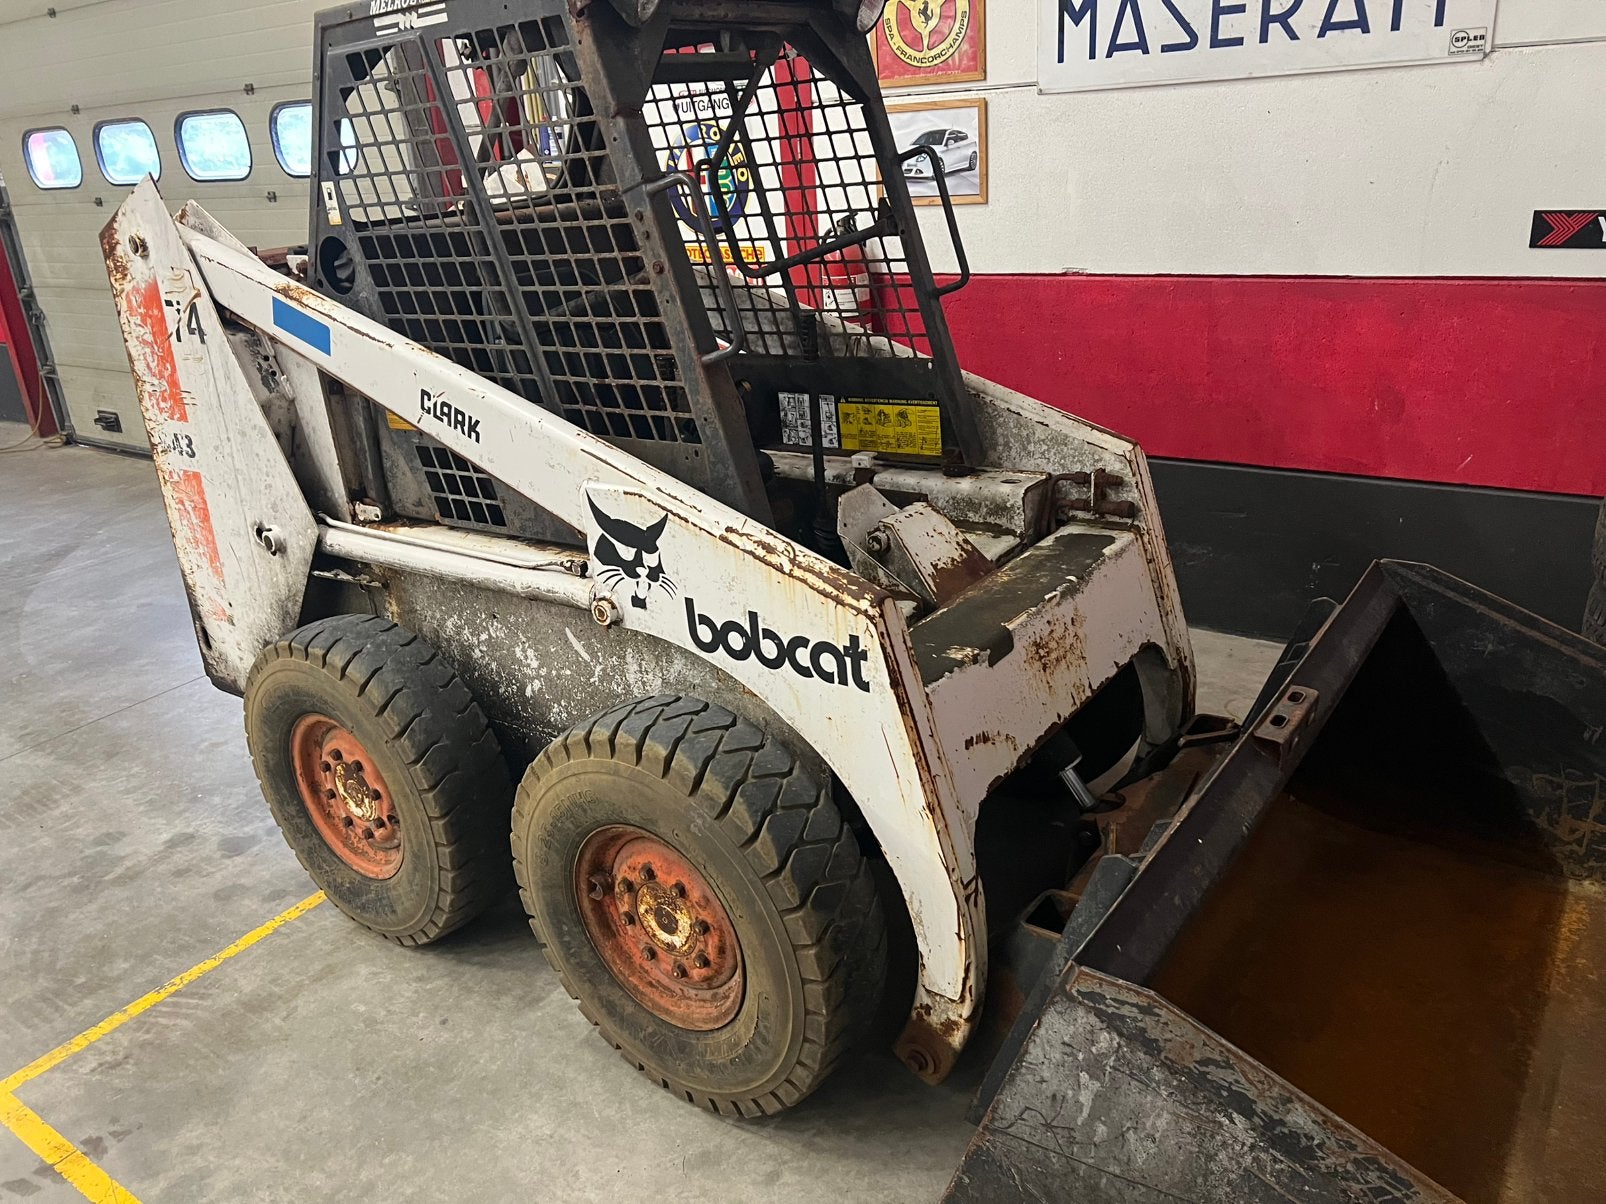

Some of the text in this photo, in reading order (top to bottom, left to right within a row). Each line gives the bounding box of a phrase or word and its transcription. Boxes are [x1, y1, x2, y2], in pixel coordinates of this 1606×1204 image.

[884, 17, 896, 42] SPA
[895, 10, 968, 64] FRANCORCHAMPS
[420, 388, 481, 444] CLARK
[685, 597, 870, 693] bobcat
